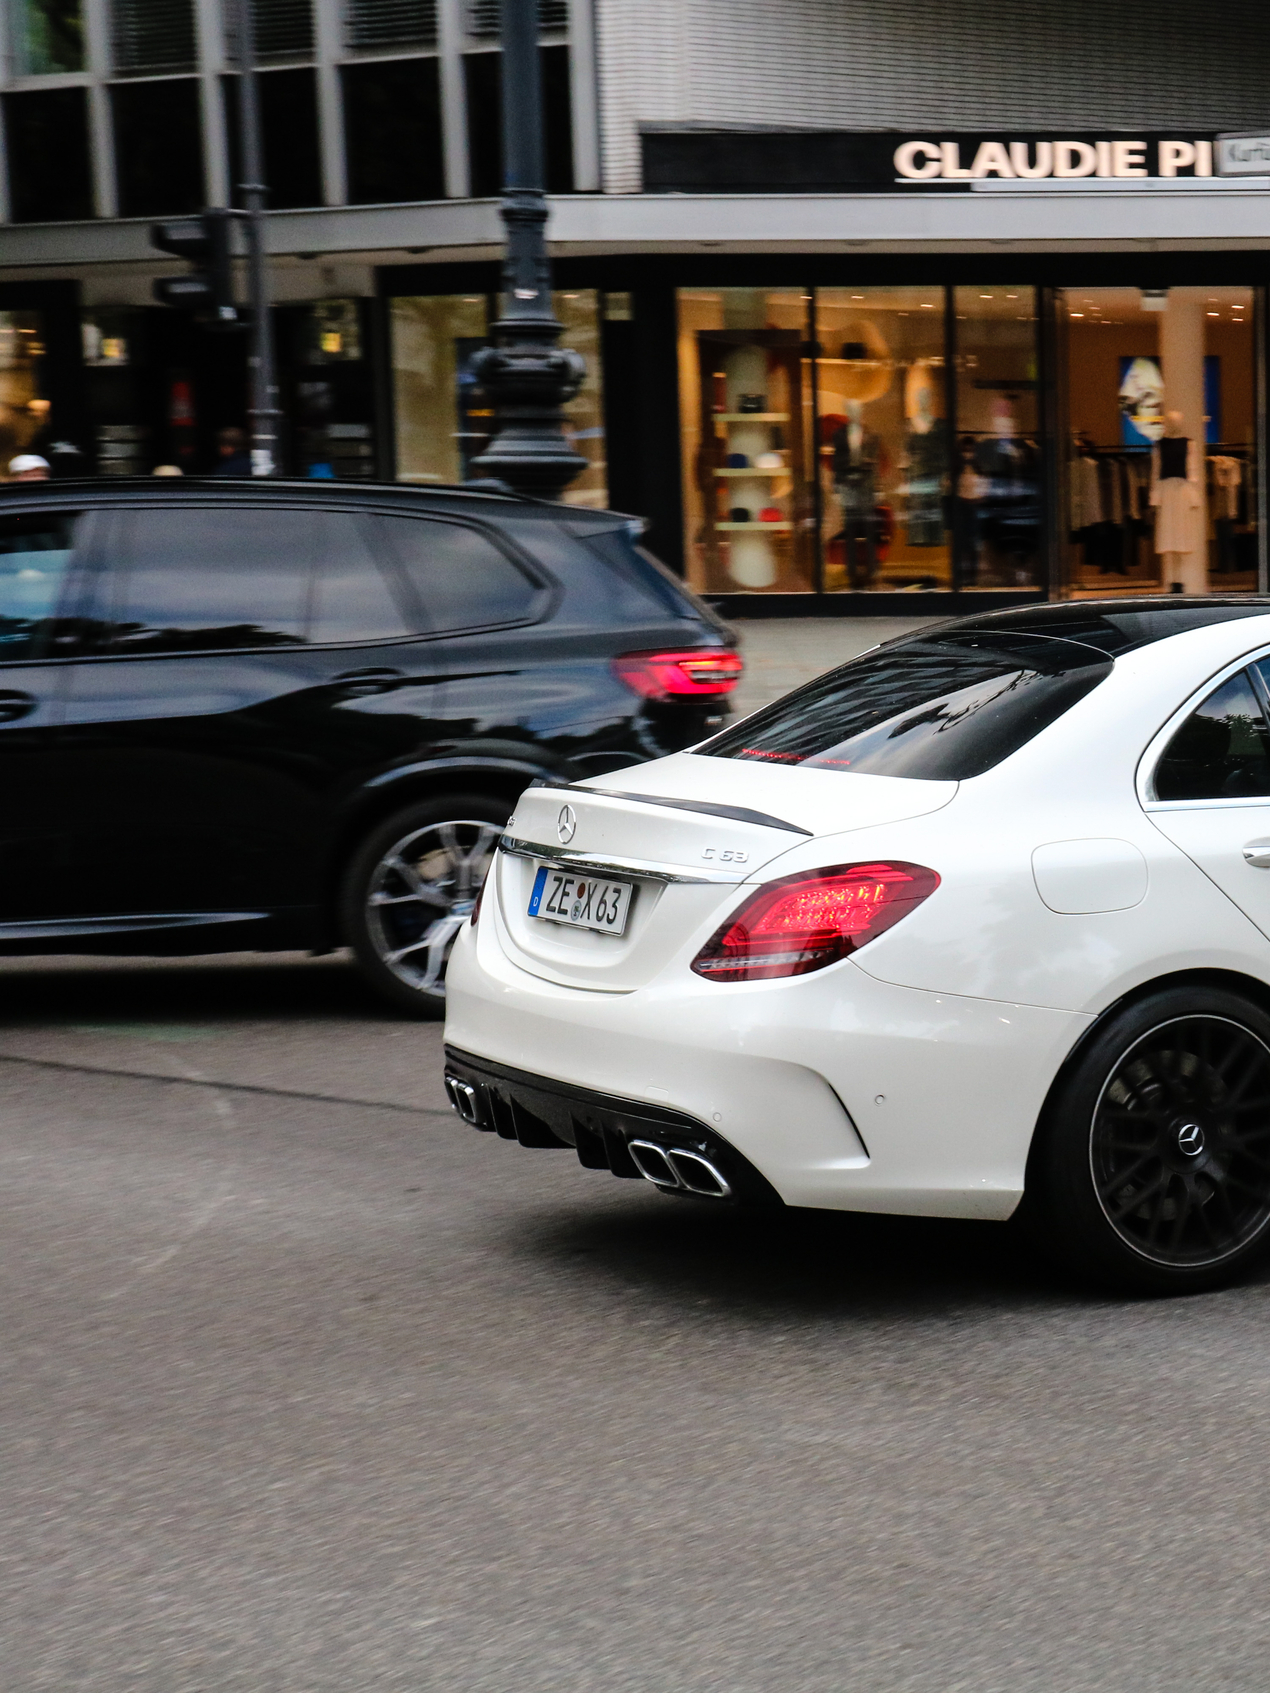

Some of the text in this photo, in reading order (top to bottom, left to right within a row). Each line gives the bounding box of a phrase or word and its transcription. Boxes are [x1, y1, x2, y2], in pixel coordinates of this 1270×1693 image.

[893, 140, 1148, 178] CLAUDIE
[701, 847, 749, 863] C 63
[545, 875, 575, 916] ZE
